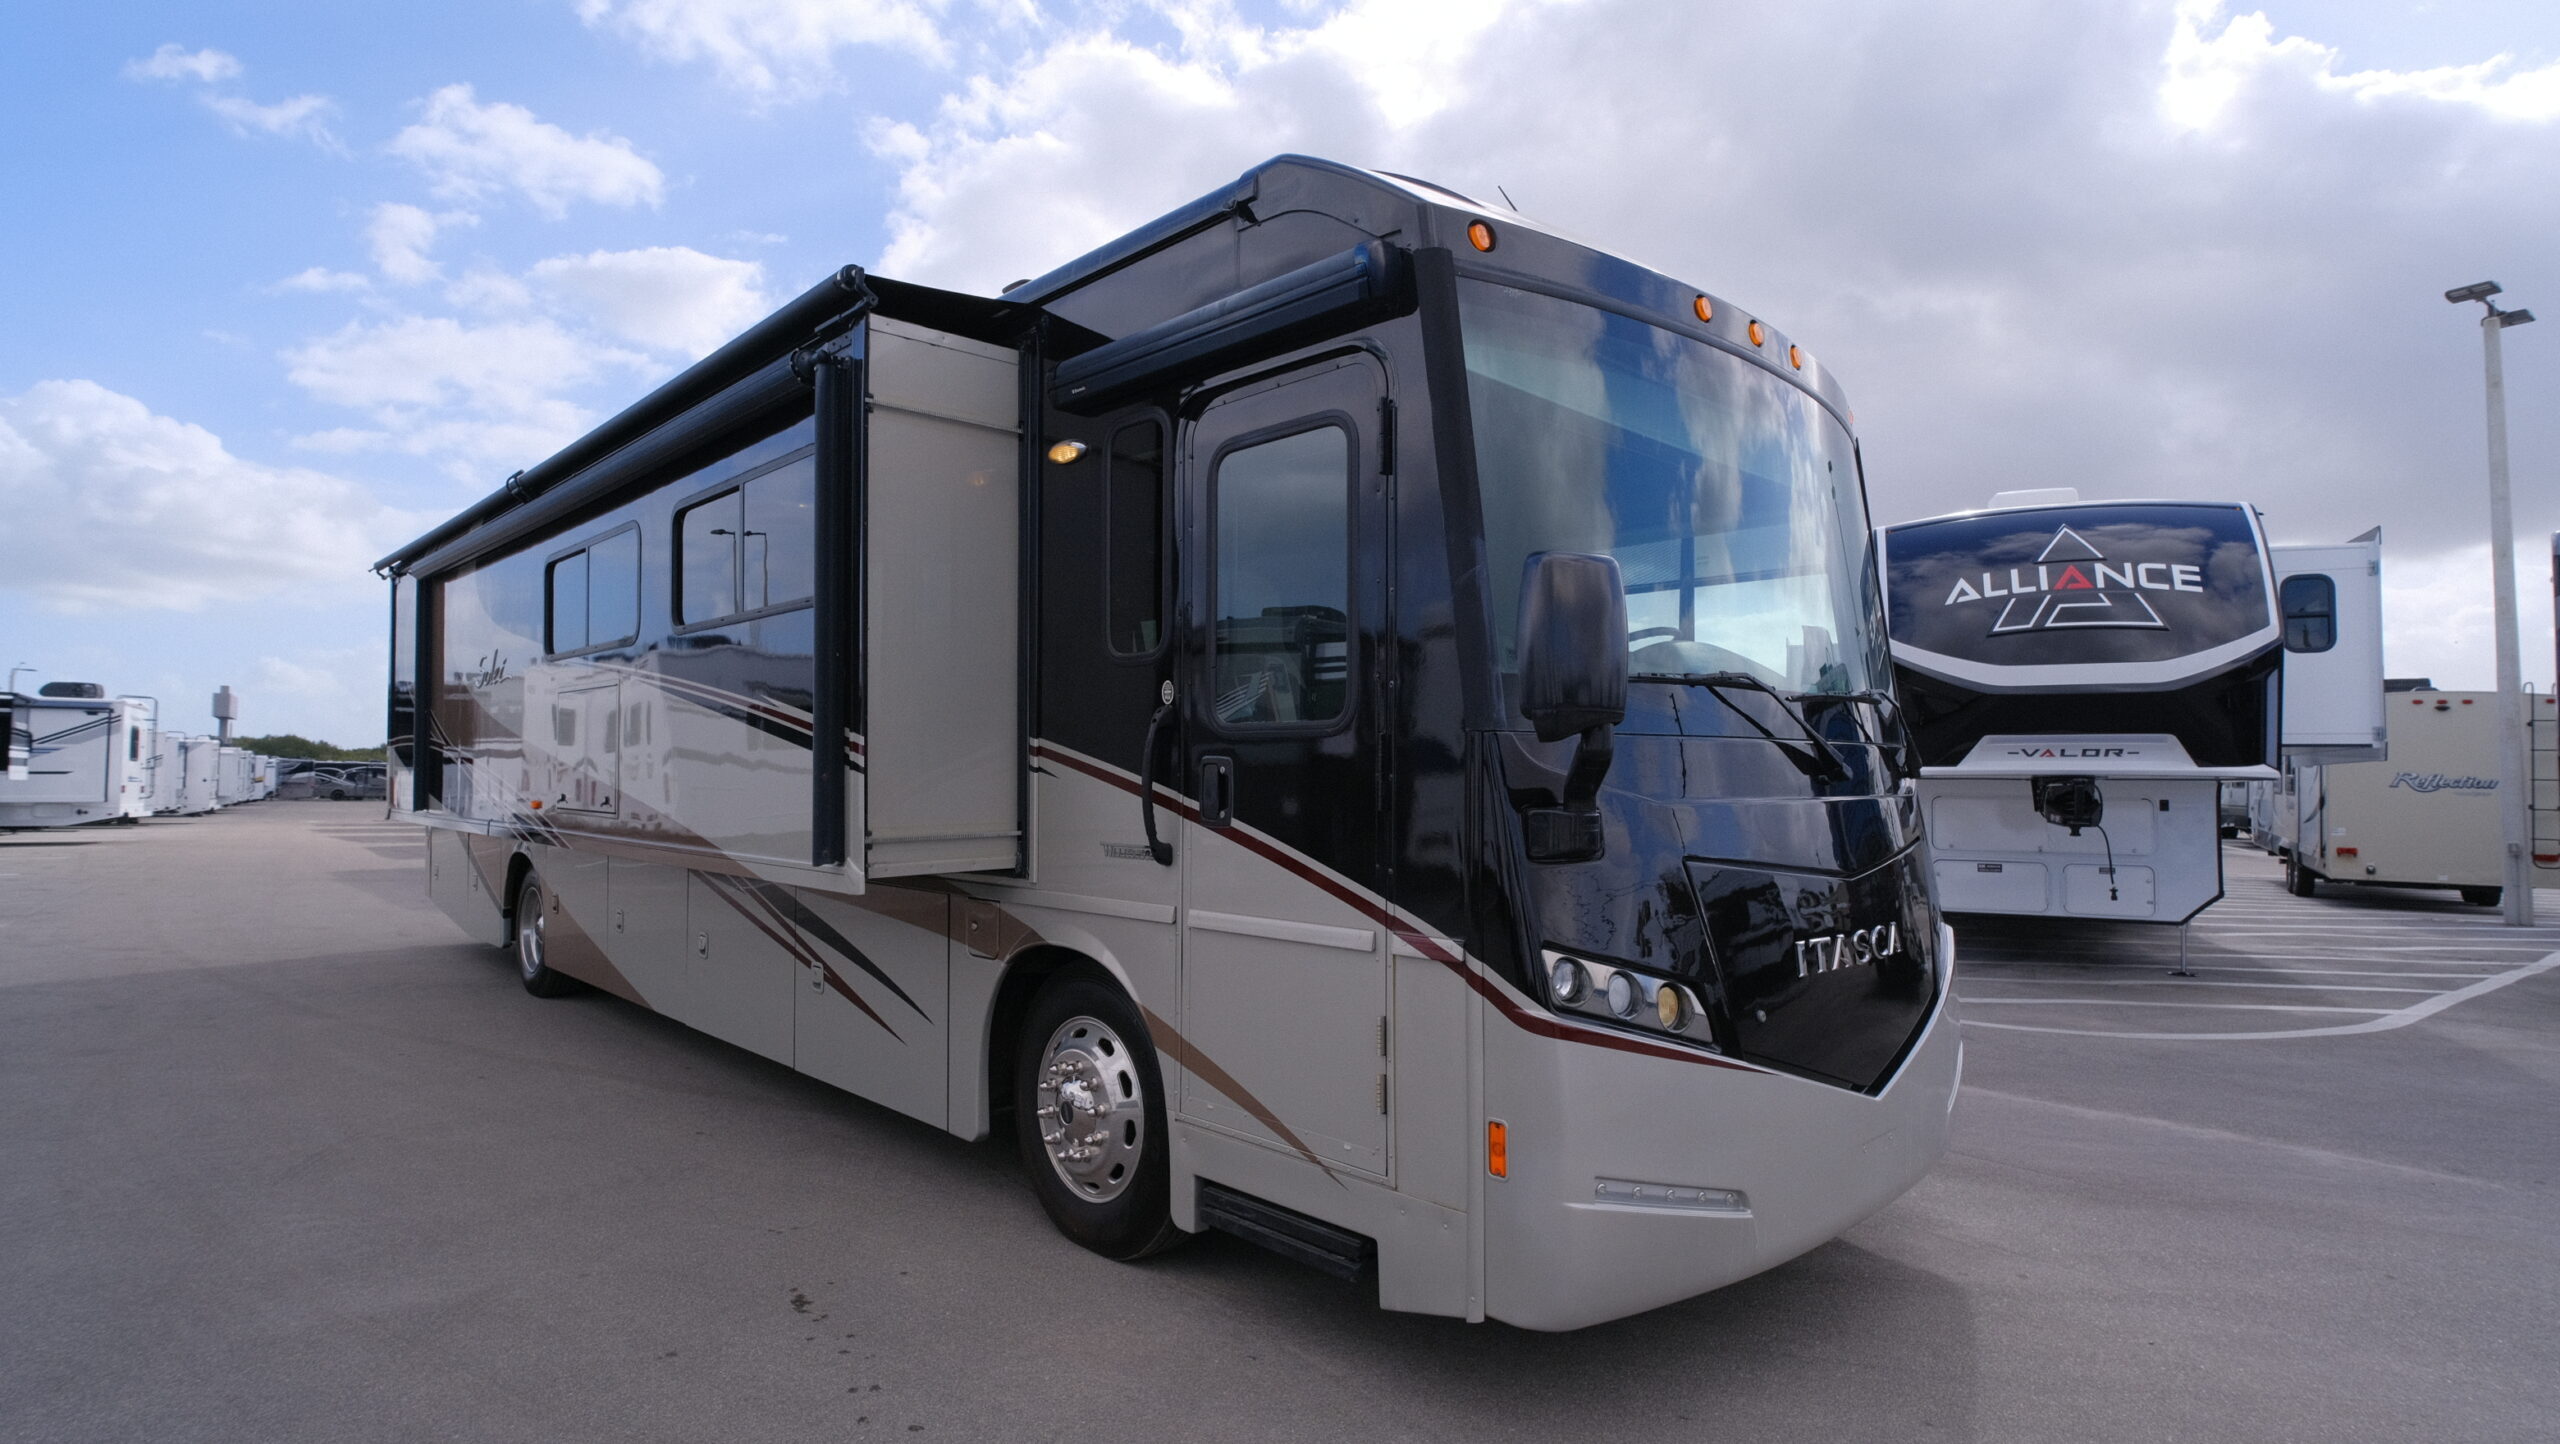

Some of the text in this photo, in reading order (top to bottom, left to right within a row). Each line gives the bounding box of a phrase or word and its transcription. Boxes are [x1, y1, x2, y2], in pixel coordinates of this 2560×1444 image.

[1945, 562, 2203, 606] ALLIANCE
[2389, 772, 2499, 793] Reflection
[1794, 921, 1902, 978] ITASCA
